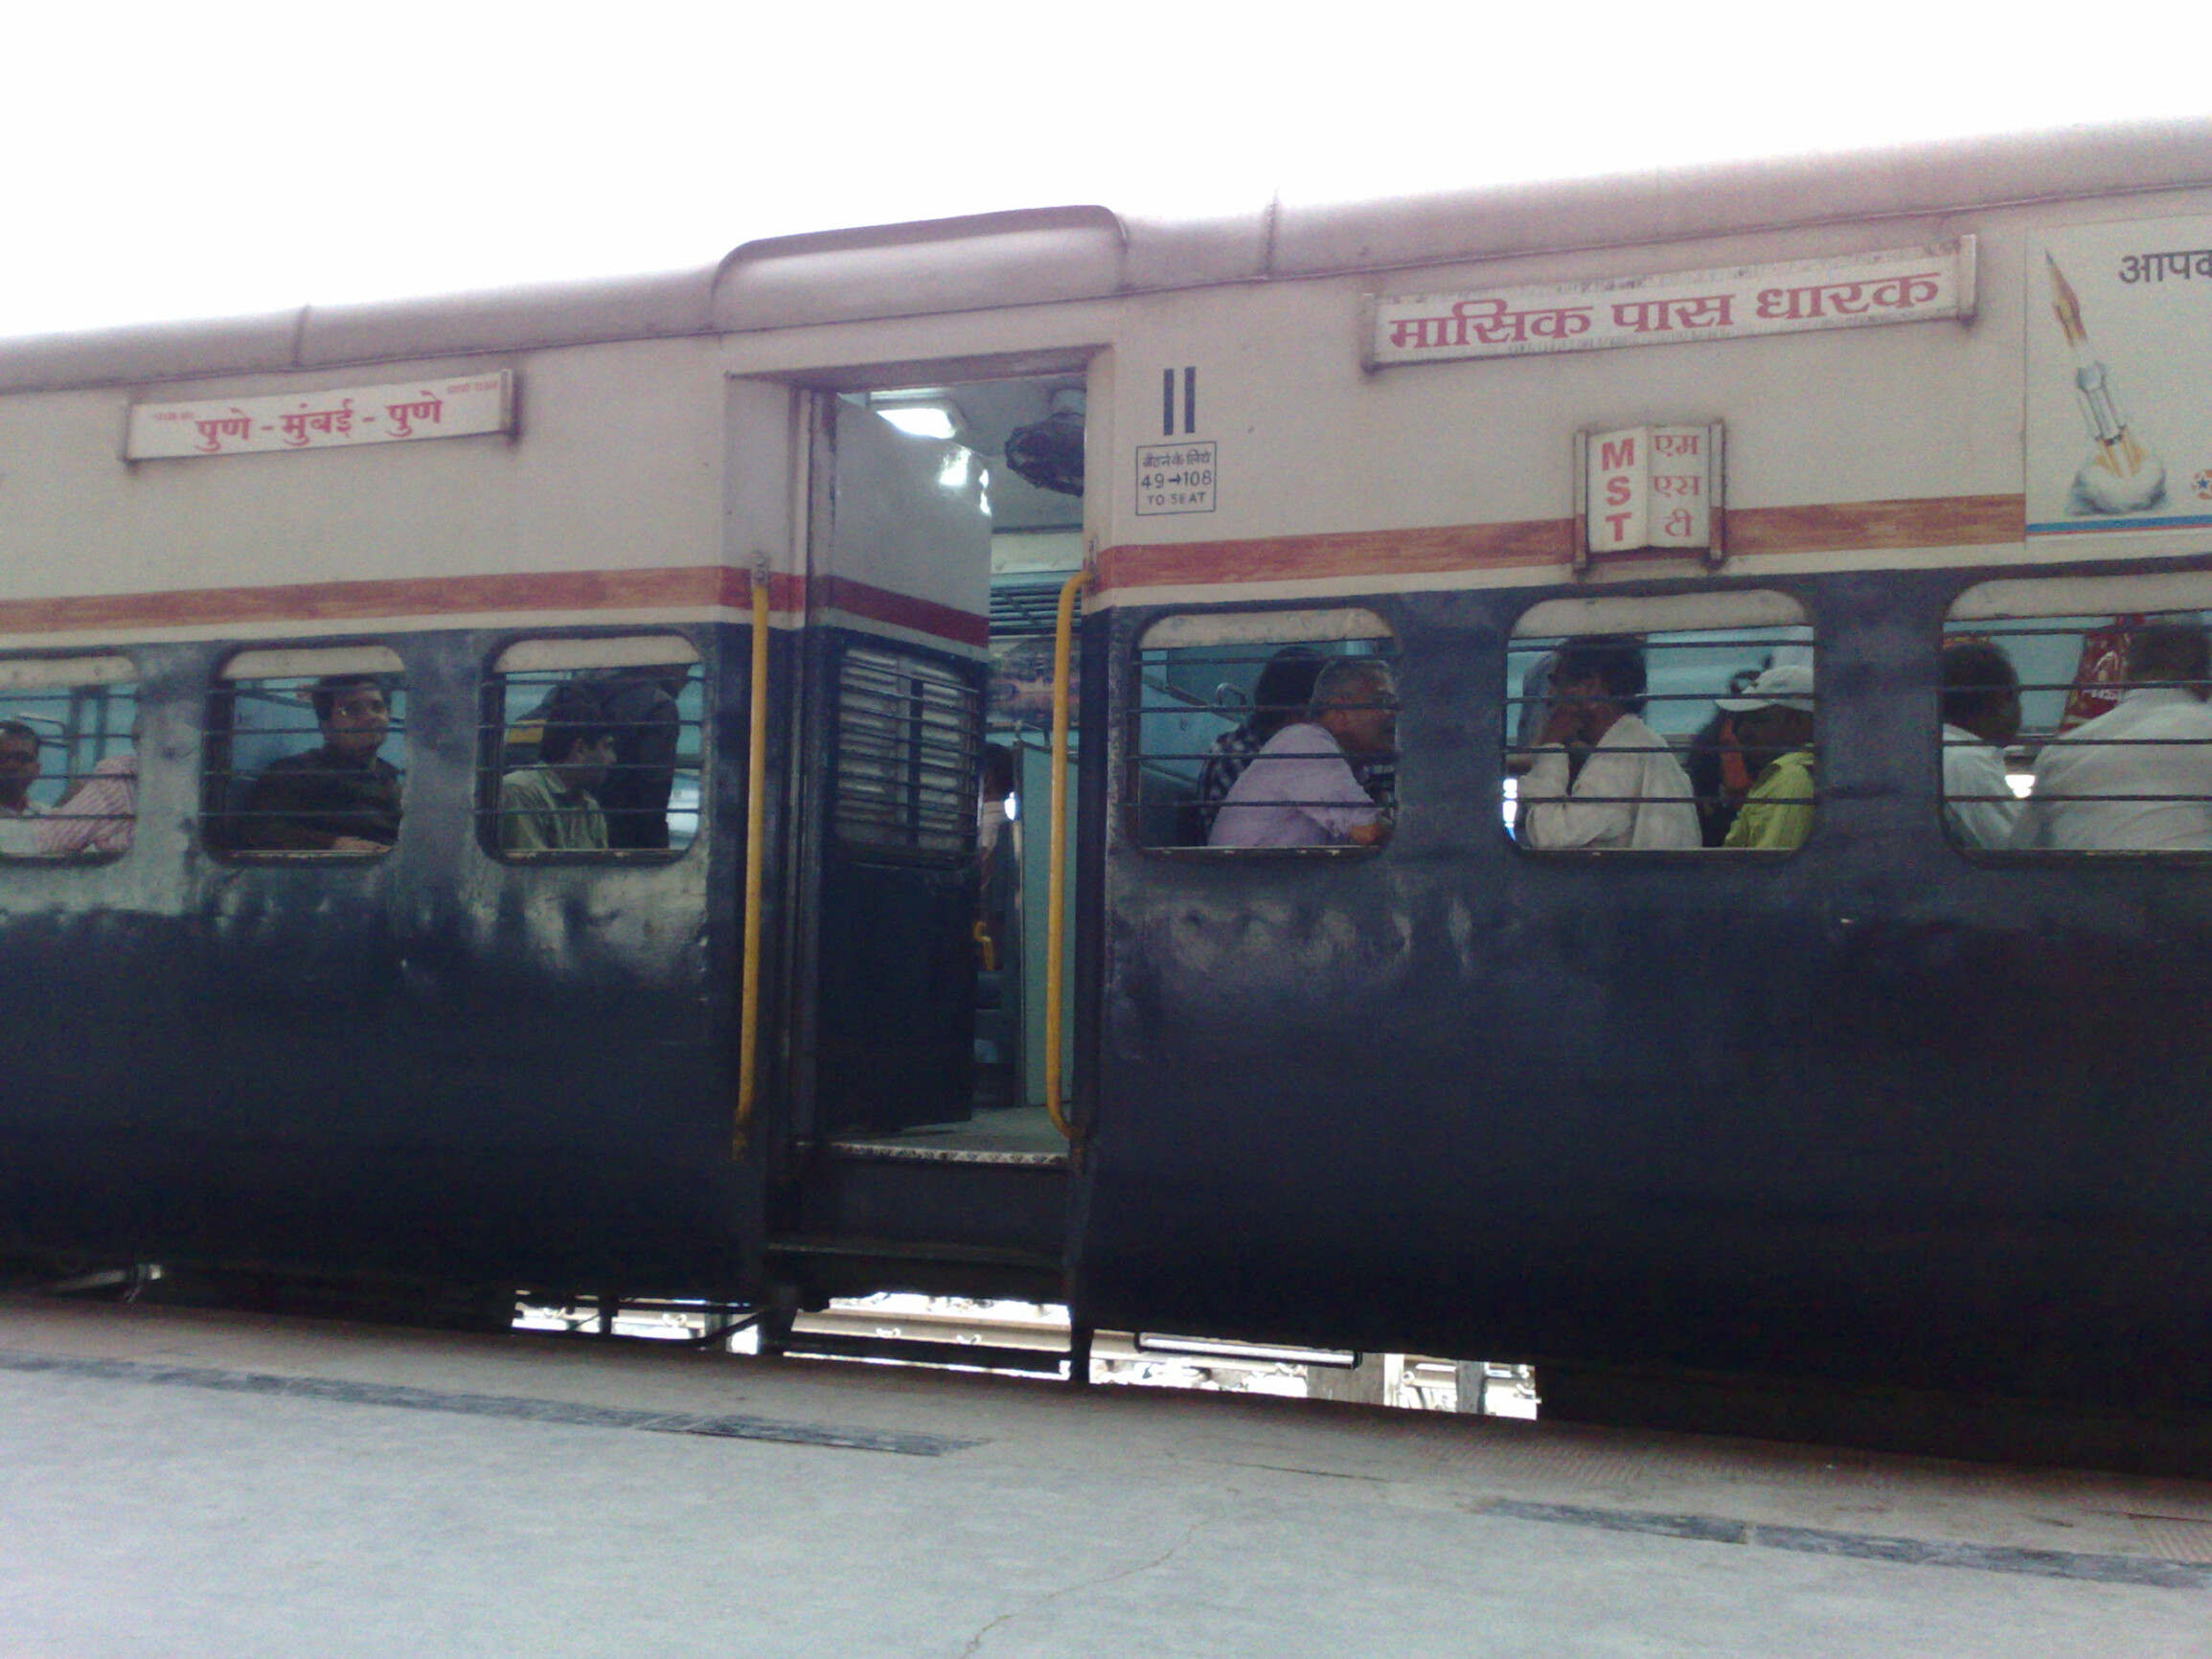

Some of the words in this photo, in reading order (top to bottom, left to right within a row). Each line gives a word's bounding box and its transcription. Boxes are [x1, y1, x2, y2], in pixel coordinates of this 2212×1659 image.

[1390, 298, 1594, 349] मासिक
[1611, 294, 1735, 332] पास
[1755, 272, 1941, 320] धारक
[194, 407, 253, 452] पुणे
[279, 398, 353, 445] मुंबई
[384, 390, 443, 438] पुणे
[1653, 435, 1699, 457] एम
[1141, 472, 1165, 489] 49
[1183, 468, 1213, 487] 108
[1652, 475, 1702, 497] एस
[1147, 493, 1165, 506] TO
[1171, 491, 1206, 505] SEAT
[1665, 508, 1694, 536] टी
